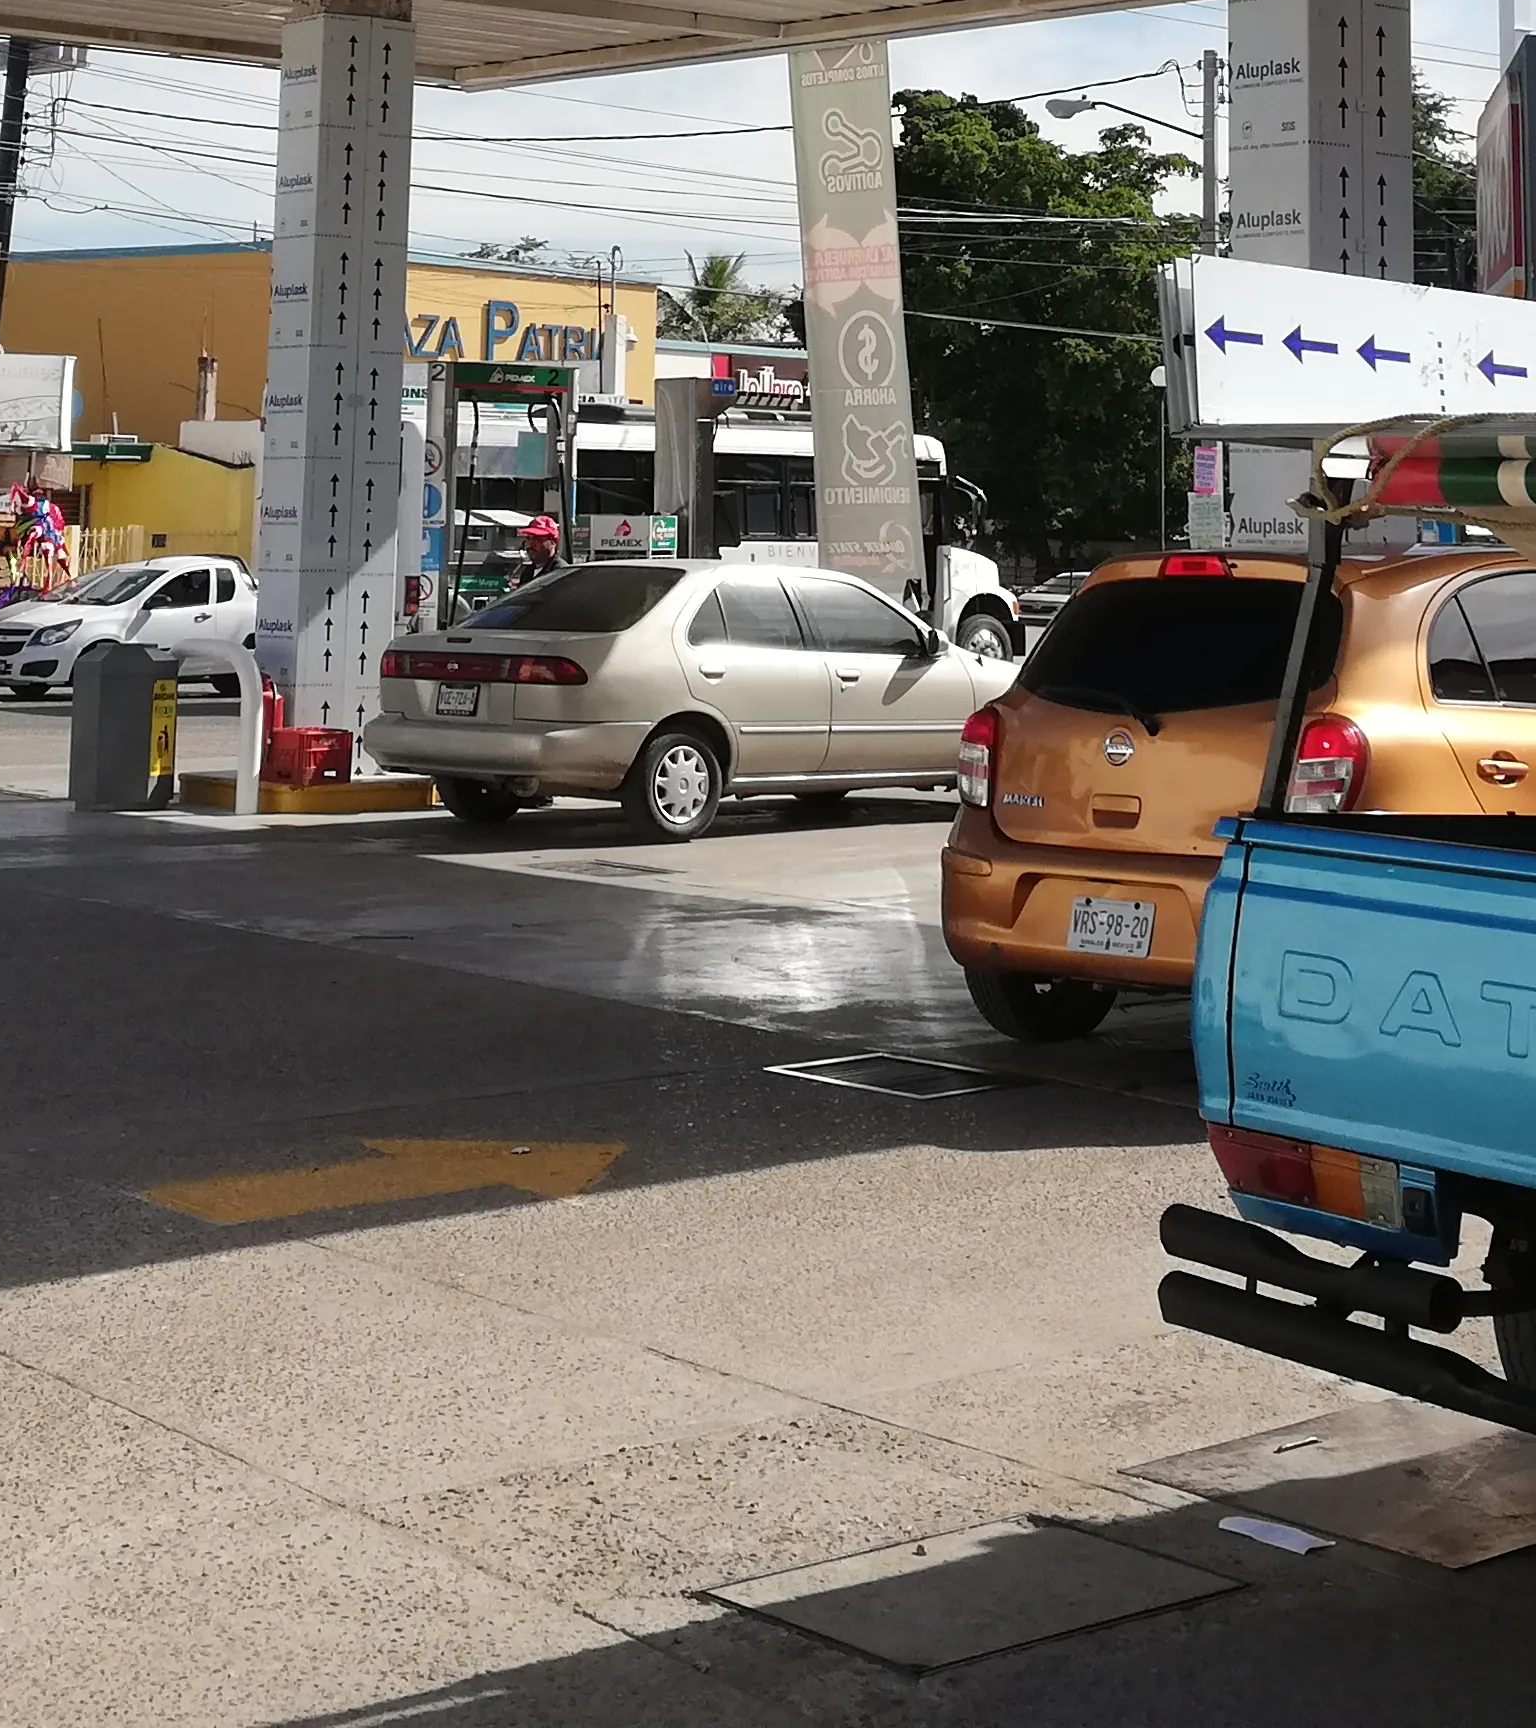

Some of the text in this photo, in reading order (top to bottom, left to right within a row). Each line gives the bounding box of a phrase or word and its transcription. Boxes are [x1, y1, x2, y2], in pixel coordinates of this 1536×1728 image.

[283, 64, 318, 80] Aluplask
[1235, 57, 1301, 80] Aluplask
[1281, 121, 1296, 132] SGS
[278, 173, 313, 189] Aluplask
[1236, 209, 1301, 230] Aluplask
[274, 283, 308, 298] Aluplask
[485, 300, 600, 361] PATRI
[431, 364, 560, 386] 2 PEMEX 2
[714, 383, 733, 393] aire
[268, 393, 303, 410] Aluplask
[264, 505, 298, 522] Aluplask
[1238, 518, 1304, 538] Aluplask
[601, 538, 643, 547] PEMEX
[768, 544, 816, 558] BIENV
[258, 618, 293, 634] Aluplask
[1002, 793, 1044, 808] MARCH
[1073, 908, 1149, 939] VRS-98-20
